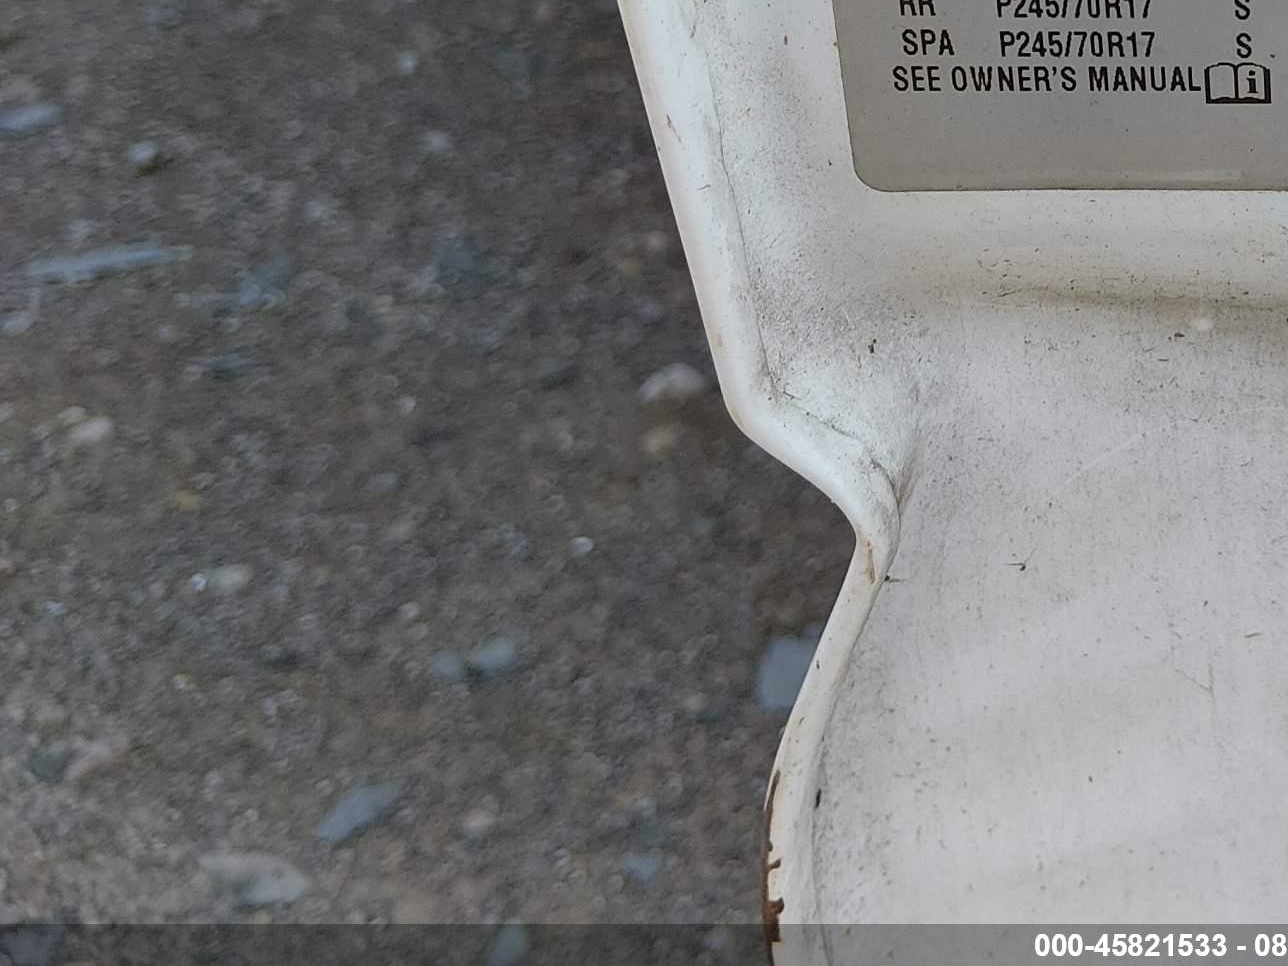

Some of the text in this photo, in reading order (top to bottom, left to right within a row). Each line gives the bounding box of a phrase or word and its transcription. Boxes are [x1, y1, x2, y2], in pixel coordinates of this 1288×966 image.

[902, 29, 954, 55] SPA
[1000, 31, 1154, 58] P245/70R17
[1236, 33, 1252, 58] S
[893, 66, 941, 91] SEE
[952, 66, 1076, 91] OWNER'S
[1089, 66, 1201, 91] MANUAL
